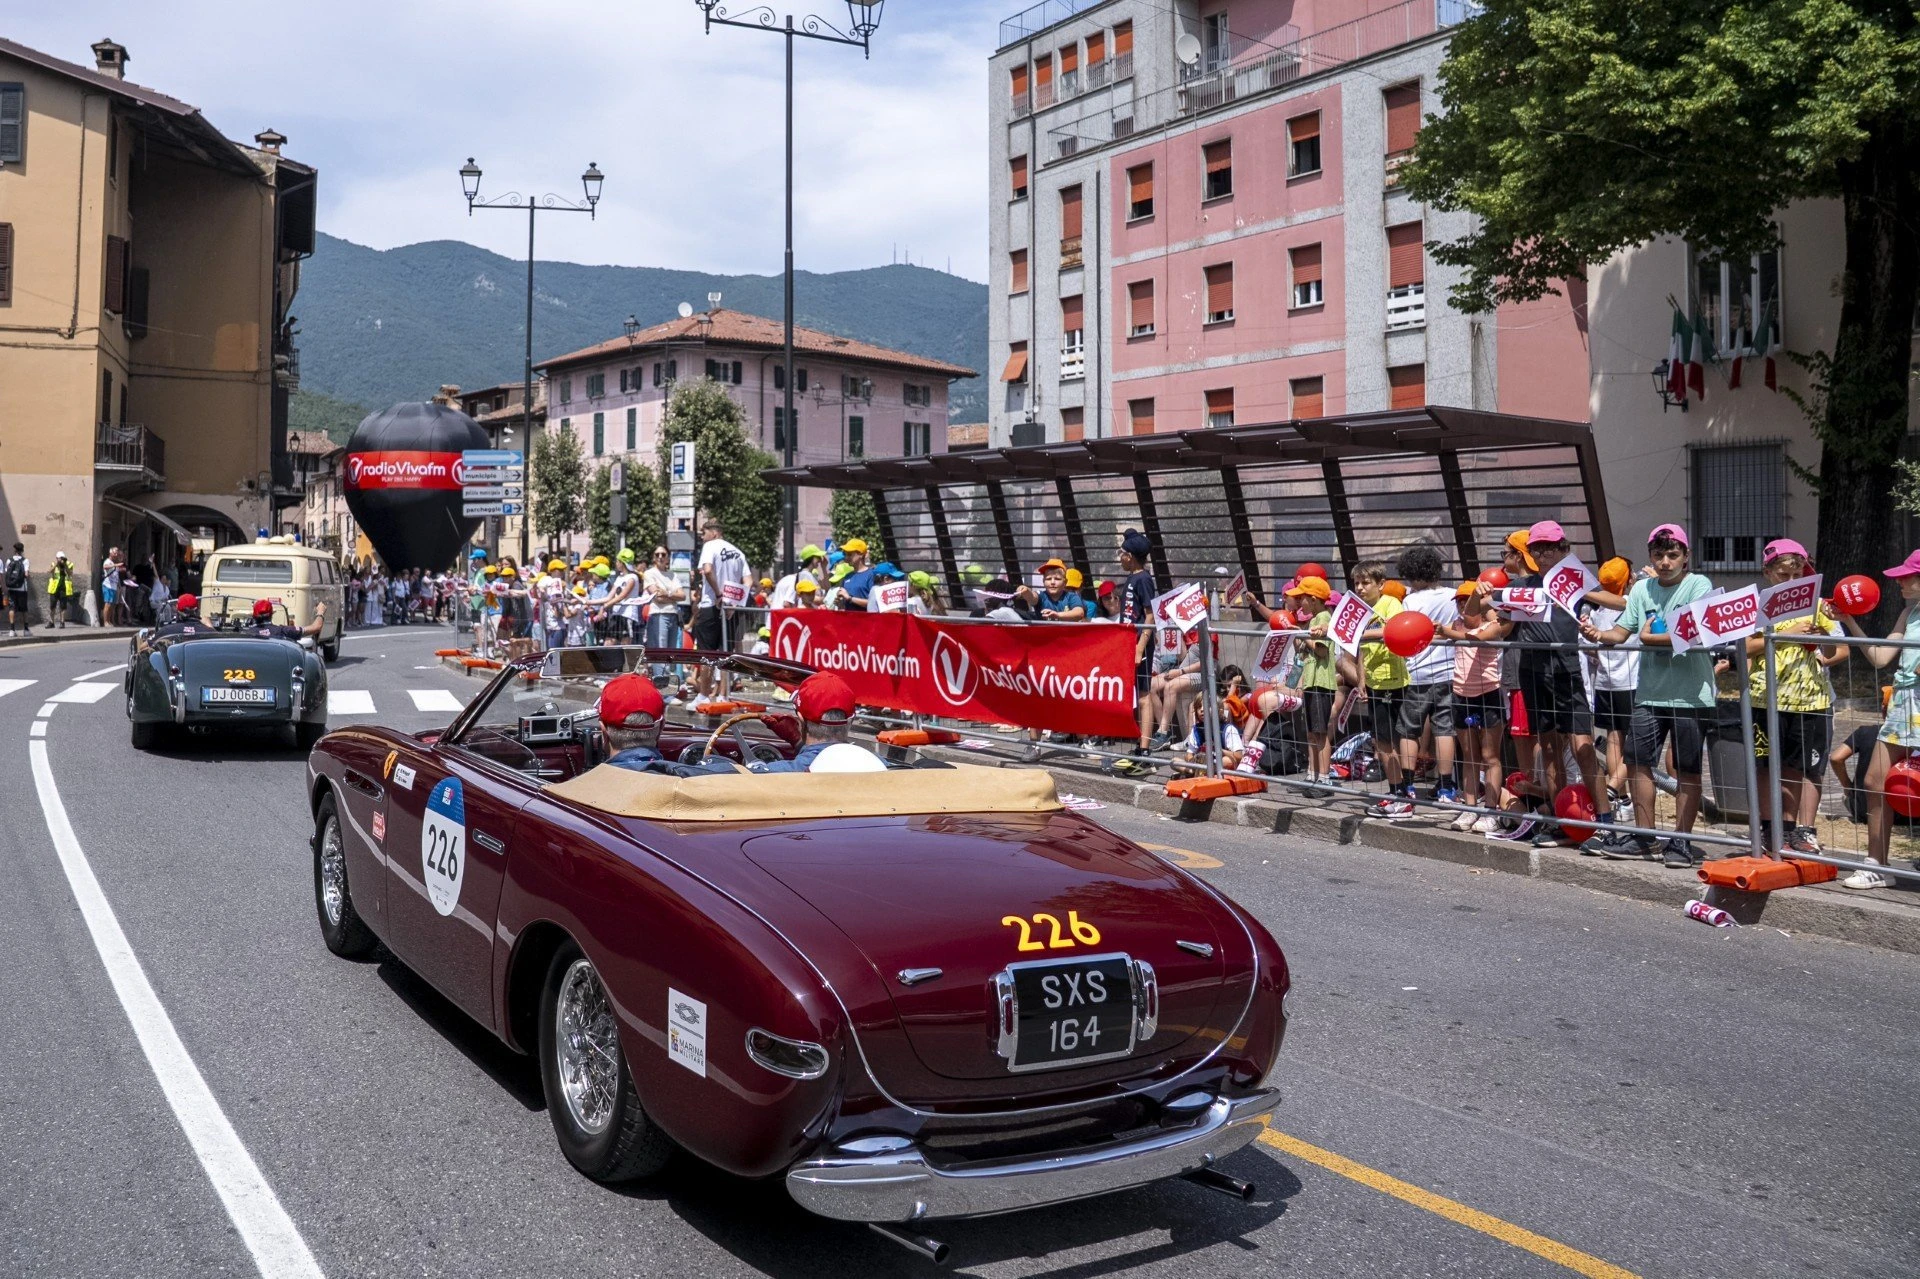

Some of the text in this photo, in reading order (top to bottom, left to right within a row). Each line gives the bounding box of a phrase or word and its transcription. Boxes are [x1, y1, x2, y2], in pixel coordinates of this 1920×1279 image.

[363, 461, 446, 477] radioVivafm
[466, 505, 502, 513] parcheggio
[1776, 586, 1810, 602] 1000
[1337, 603, 1355, 631] 1000
[1715, 599, 1753, 617] 1000
[1771, 597, 1811, 616] MIGLIA
[1344, 607, 1366, 640] MIGLIA
[1264, 637, 1278, 662] 1000
[814, 643, 920, 679] radioVivafm
[224, 669, 256, 680] 228
[980, 664, 1124, 702] radioVivafm
[212, 689, 226, 700] DJ
[230, 689, 266, 700] 006BJ
[426, 824, 458, 882] 226
[1001, 910, 1101, 951] 226
[1041, 970, 1107, 1009] SXS
[1049, 1015, 1101, 1052] 164
[679, 1039, 703, 1057] MARINA
[679, 1049, 704, 1067] MILITARE
